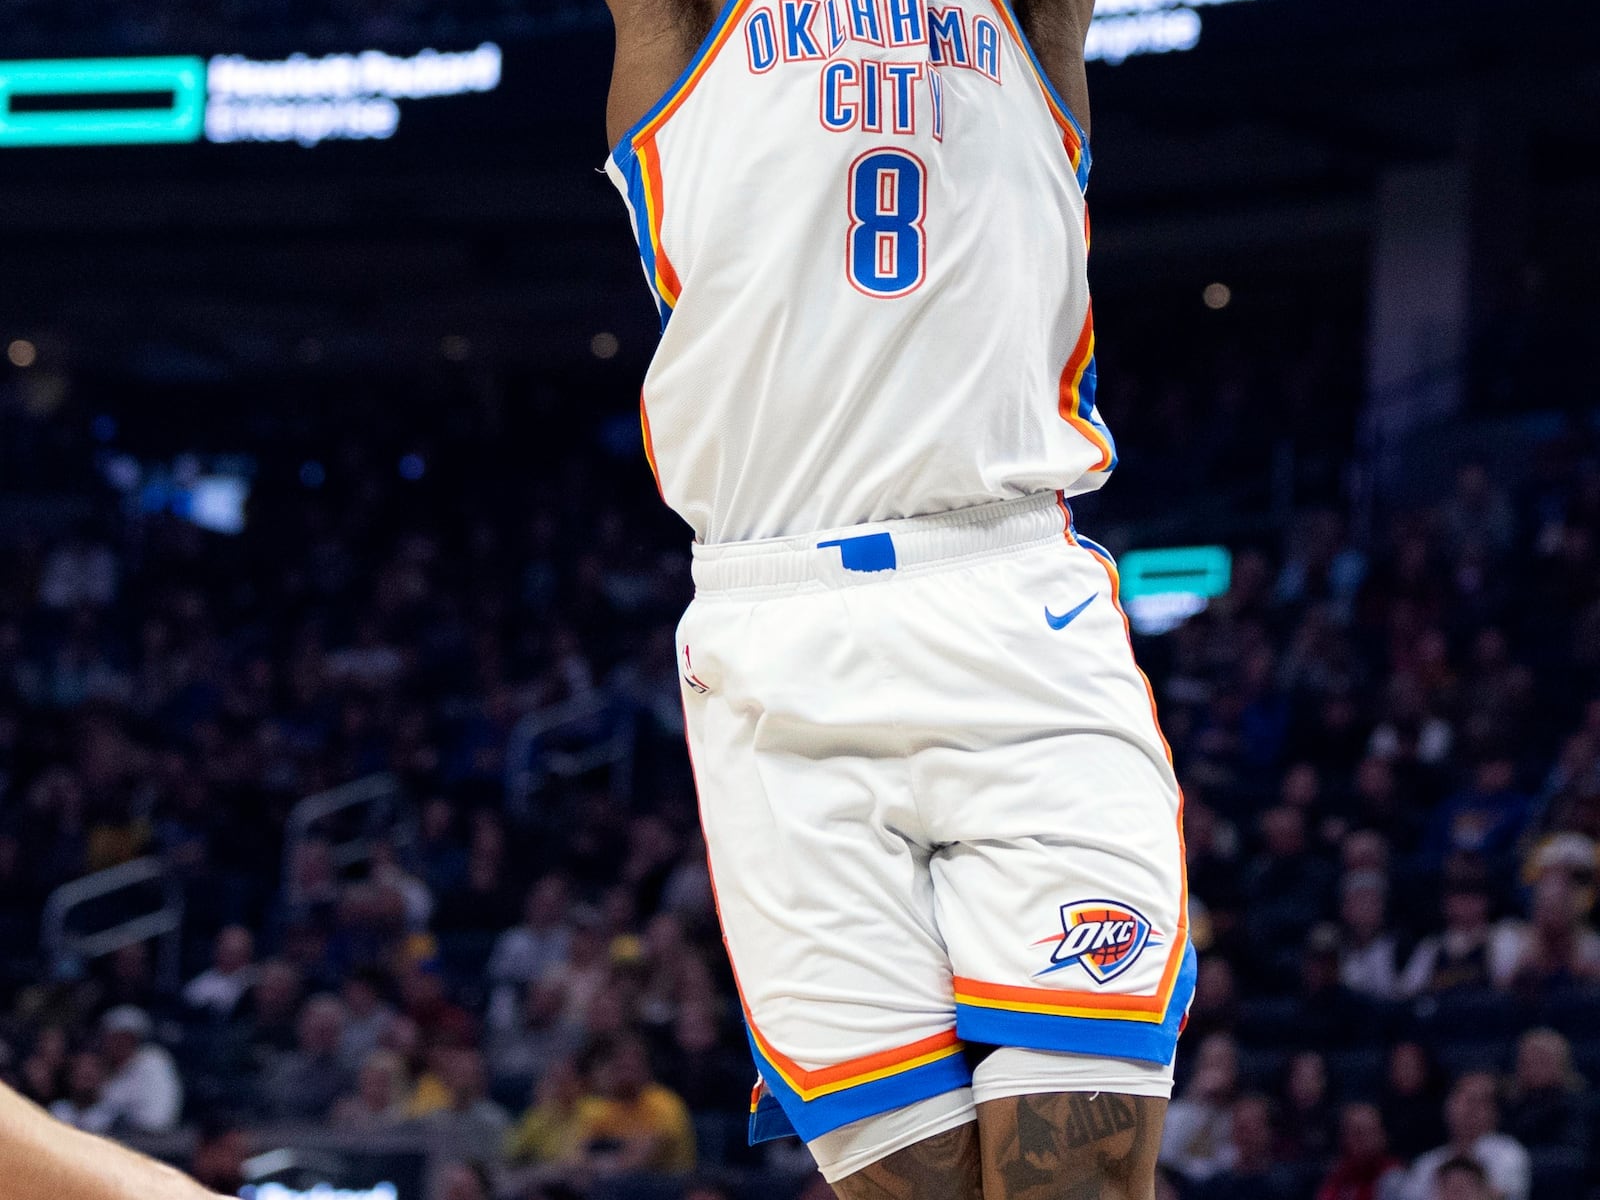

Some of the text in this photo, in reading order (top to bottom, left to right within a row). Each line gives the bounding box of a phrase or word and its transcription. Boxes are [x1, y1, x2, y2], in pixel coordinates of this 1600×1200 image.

[820, 58, 943, 144] CITY
[846, 146, 928, 300] 8
[1051, 920, 1136, 962] OKC
